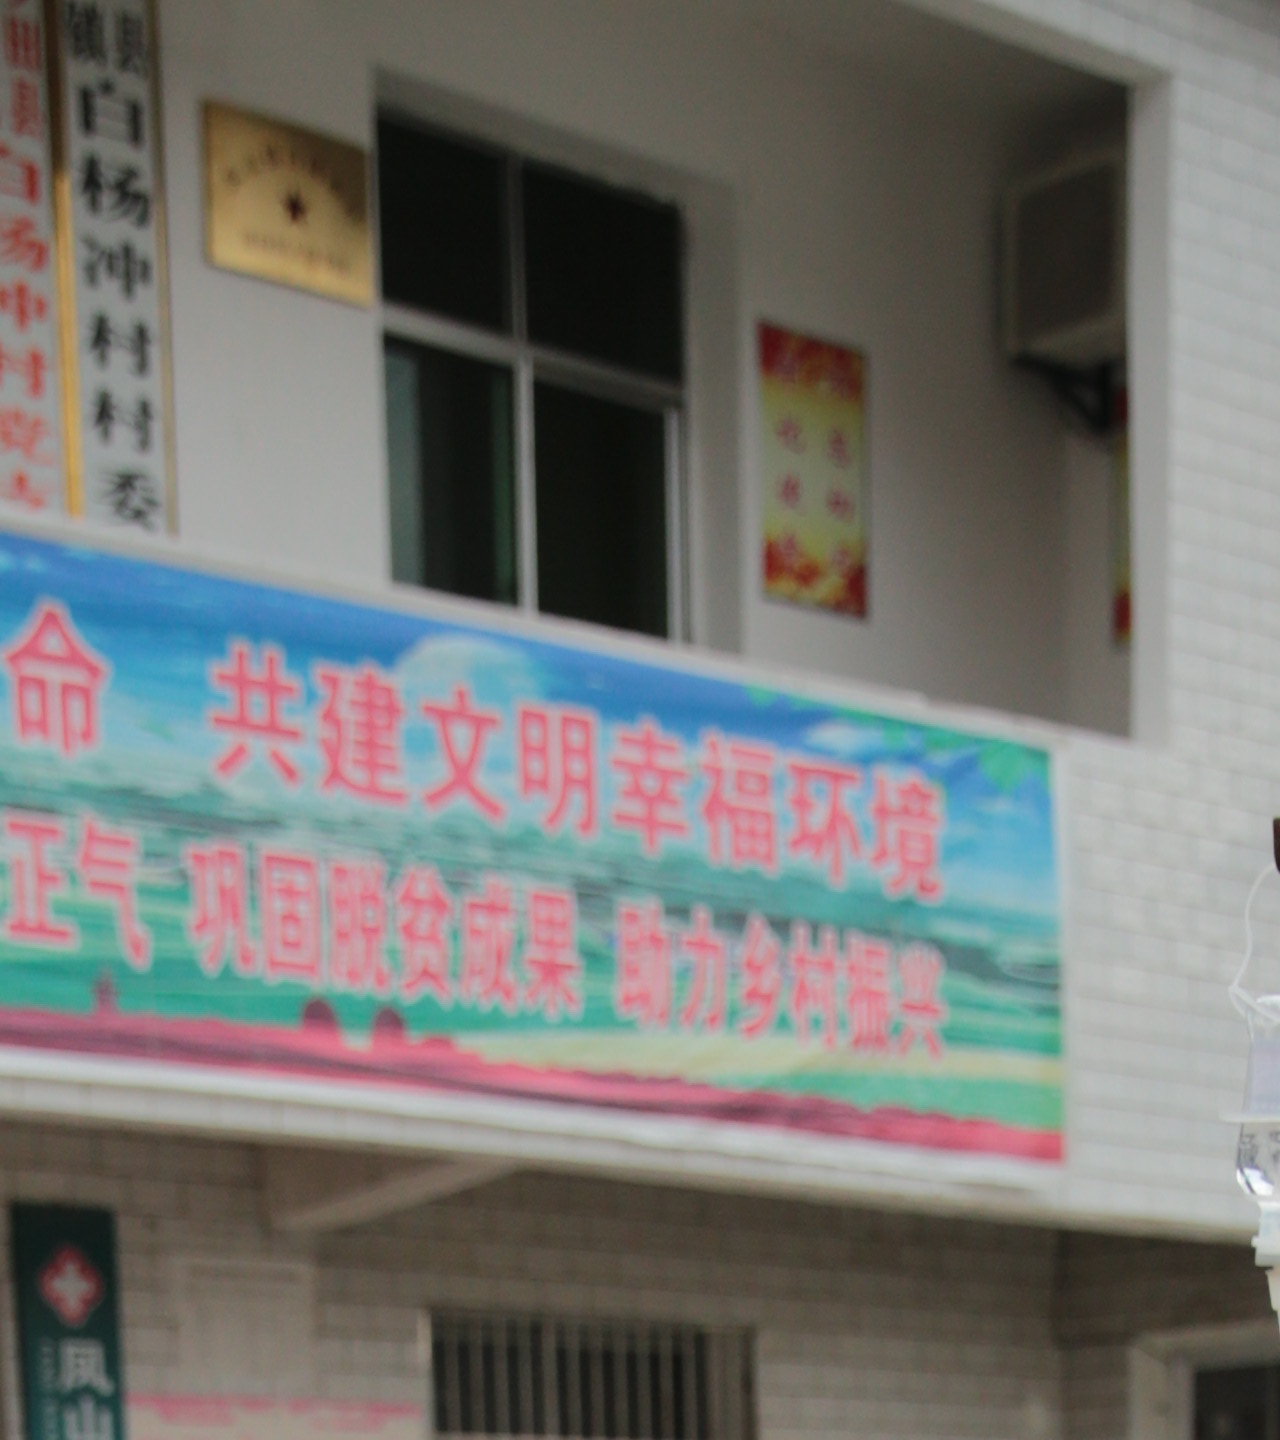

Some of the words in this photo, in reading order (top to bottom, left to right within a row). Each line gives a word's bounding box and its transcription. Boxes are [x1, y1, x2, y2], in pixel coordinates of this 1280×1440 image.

[210, 640, 945, 904] 共建文明幸福环境
[187, 843, 583, 1018] 巩固脱贫成果
[614, 902, 948, 1061] 助力乡村振兴
